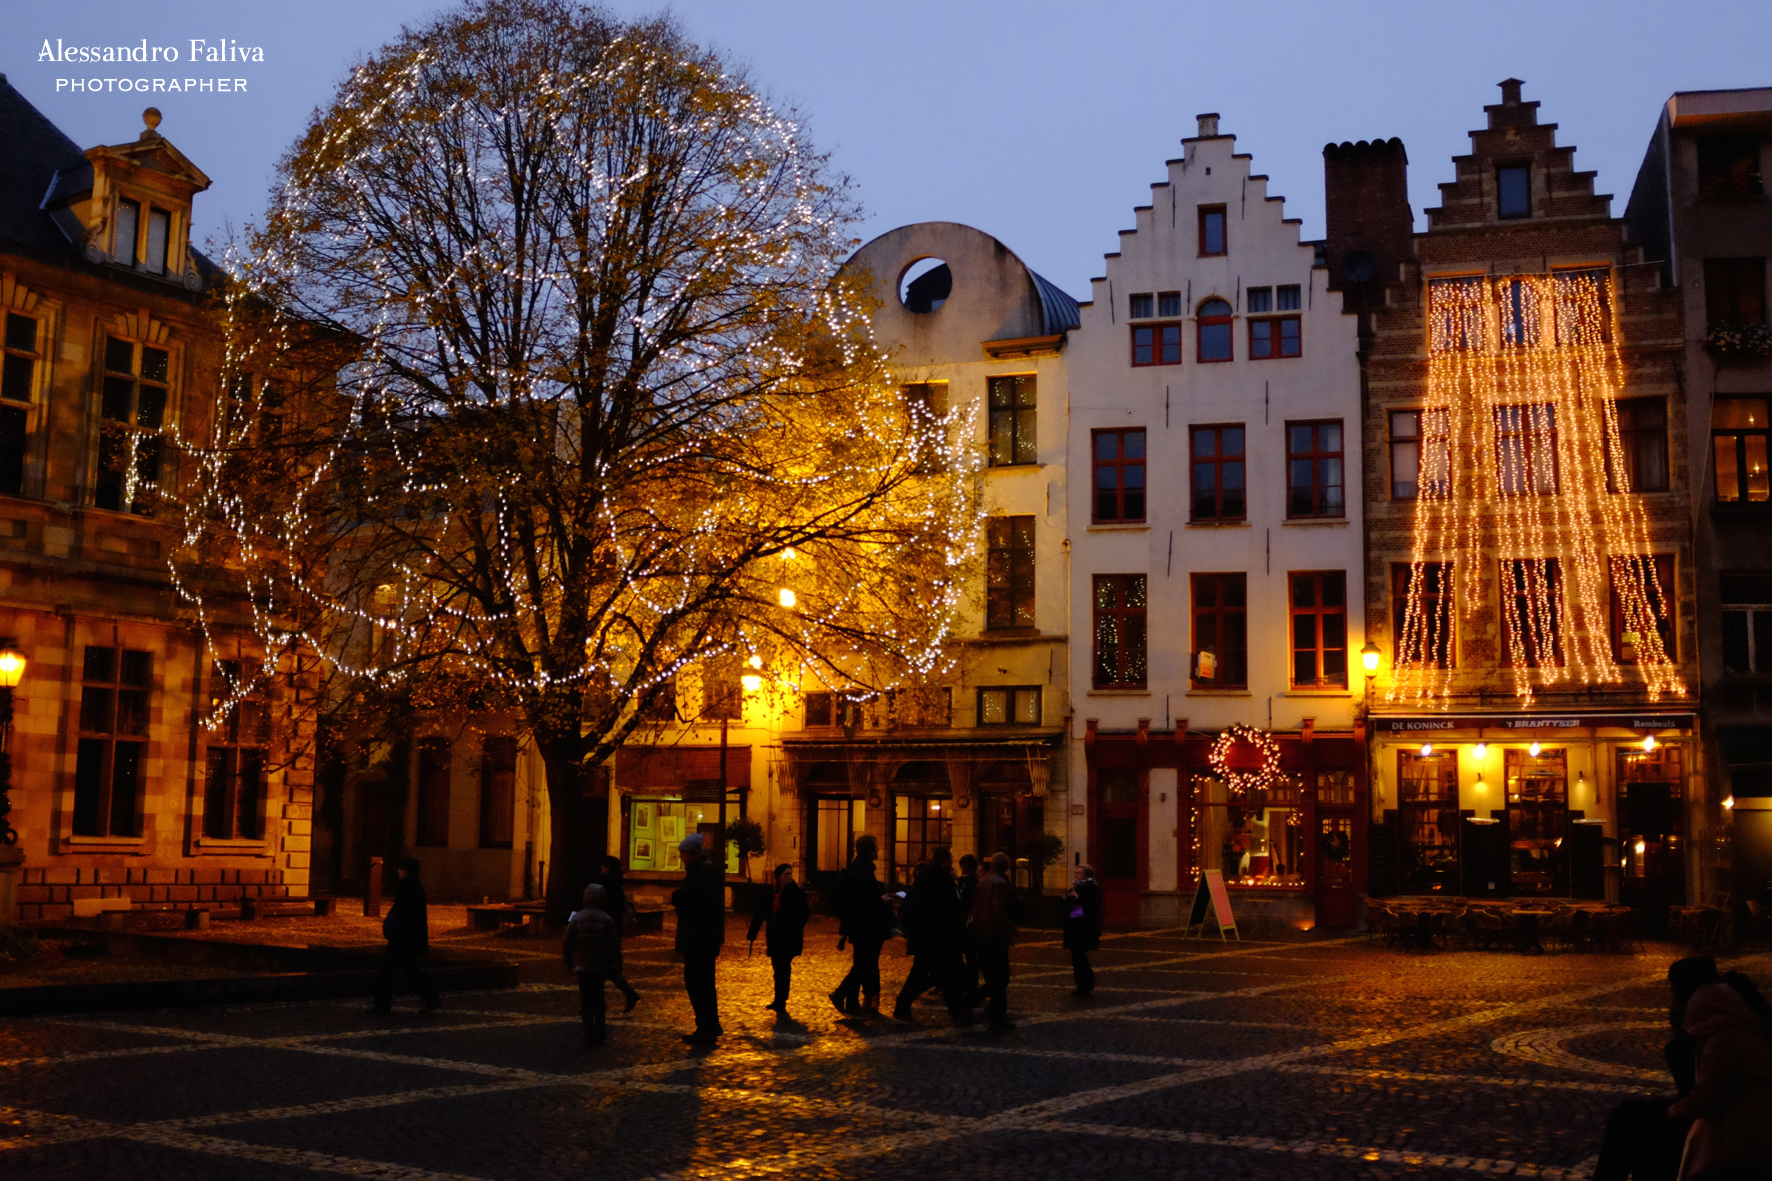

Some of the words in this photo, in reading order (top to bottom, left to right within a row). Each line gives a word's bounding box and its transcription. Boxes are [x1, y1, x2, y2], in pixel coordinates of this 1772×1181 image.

[1391, 722, 1405, 730] DE
[1406, 721, 1455, 730] KONINCK
[1514, 719, 1581, 728] BRANTYSER
[1633, 720, 1676, 728] Rombouts
